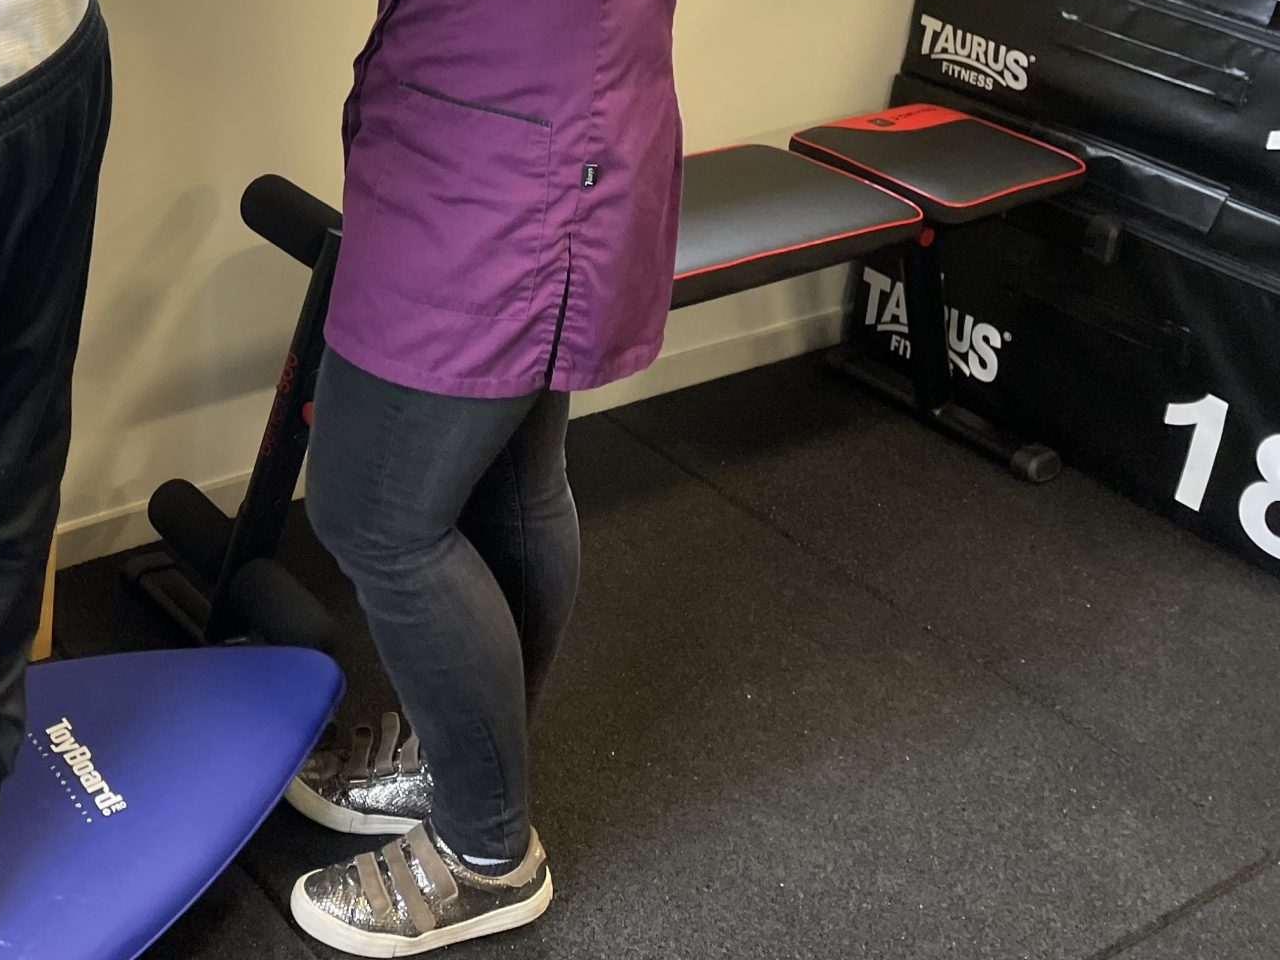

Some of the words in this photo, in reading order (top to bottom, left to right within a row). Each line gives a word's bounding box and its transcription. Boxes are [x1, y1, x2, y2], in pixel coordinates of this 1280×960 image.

[920, 13, 1029, 91] TAURUS
[942, 60, 994, 91] FITNESS
[862, 266, 1002, 383] TAUS
[45, 717, 124, 810] ToyBoard
